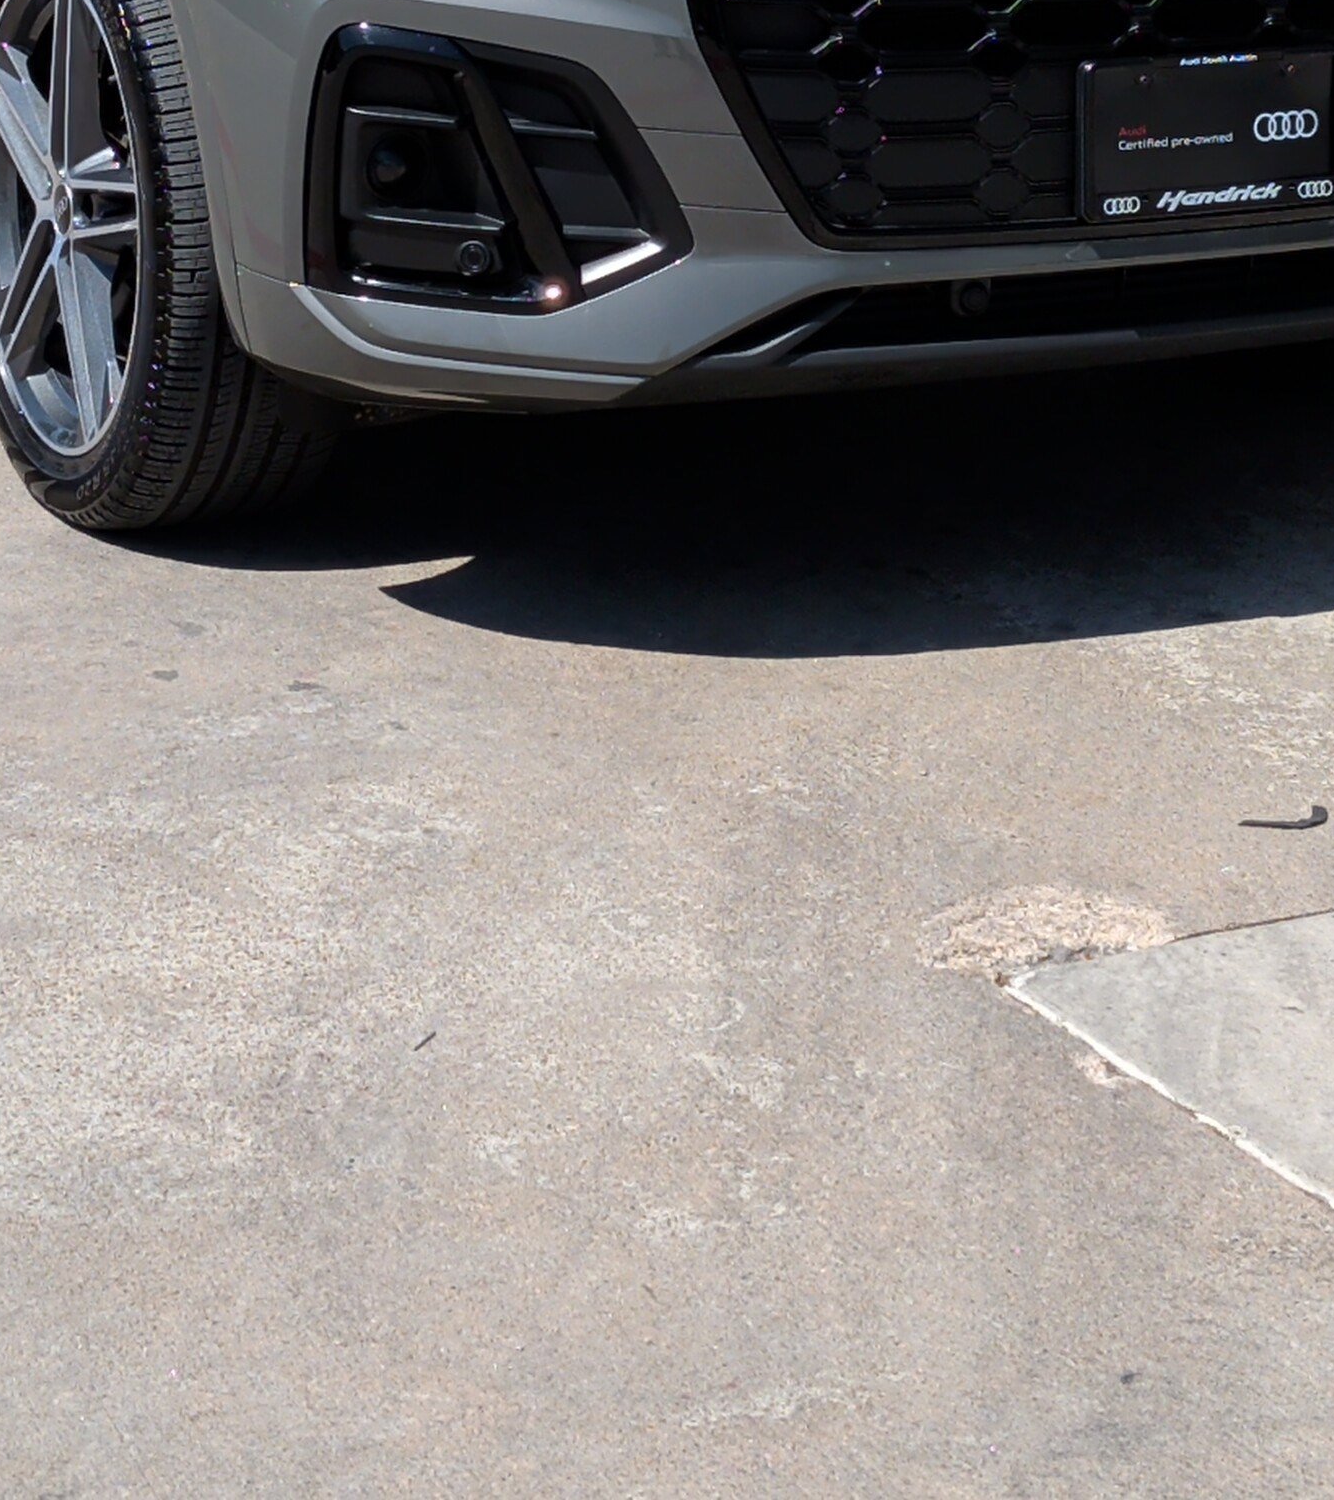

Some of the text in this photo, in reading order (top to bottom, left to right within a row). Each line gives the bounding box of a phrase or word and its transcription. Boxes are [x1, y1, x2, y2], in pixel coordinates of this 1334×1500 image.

[1118, 125, 1147, 137] Audi
[1118, 132, 1234, 151] Certified pre-owned
[1156, 182, 1283, 213] Hendrick
